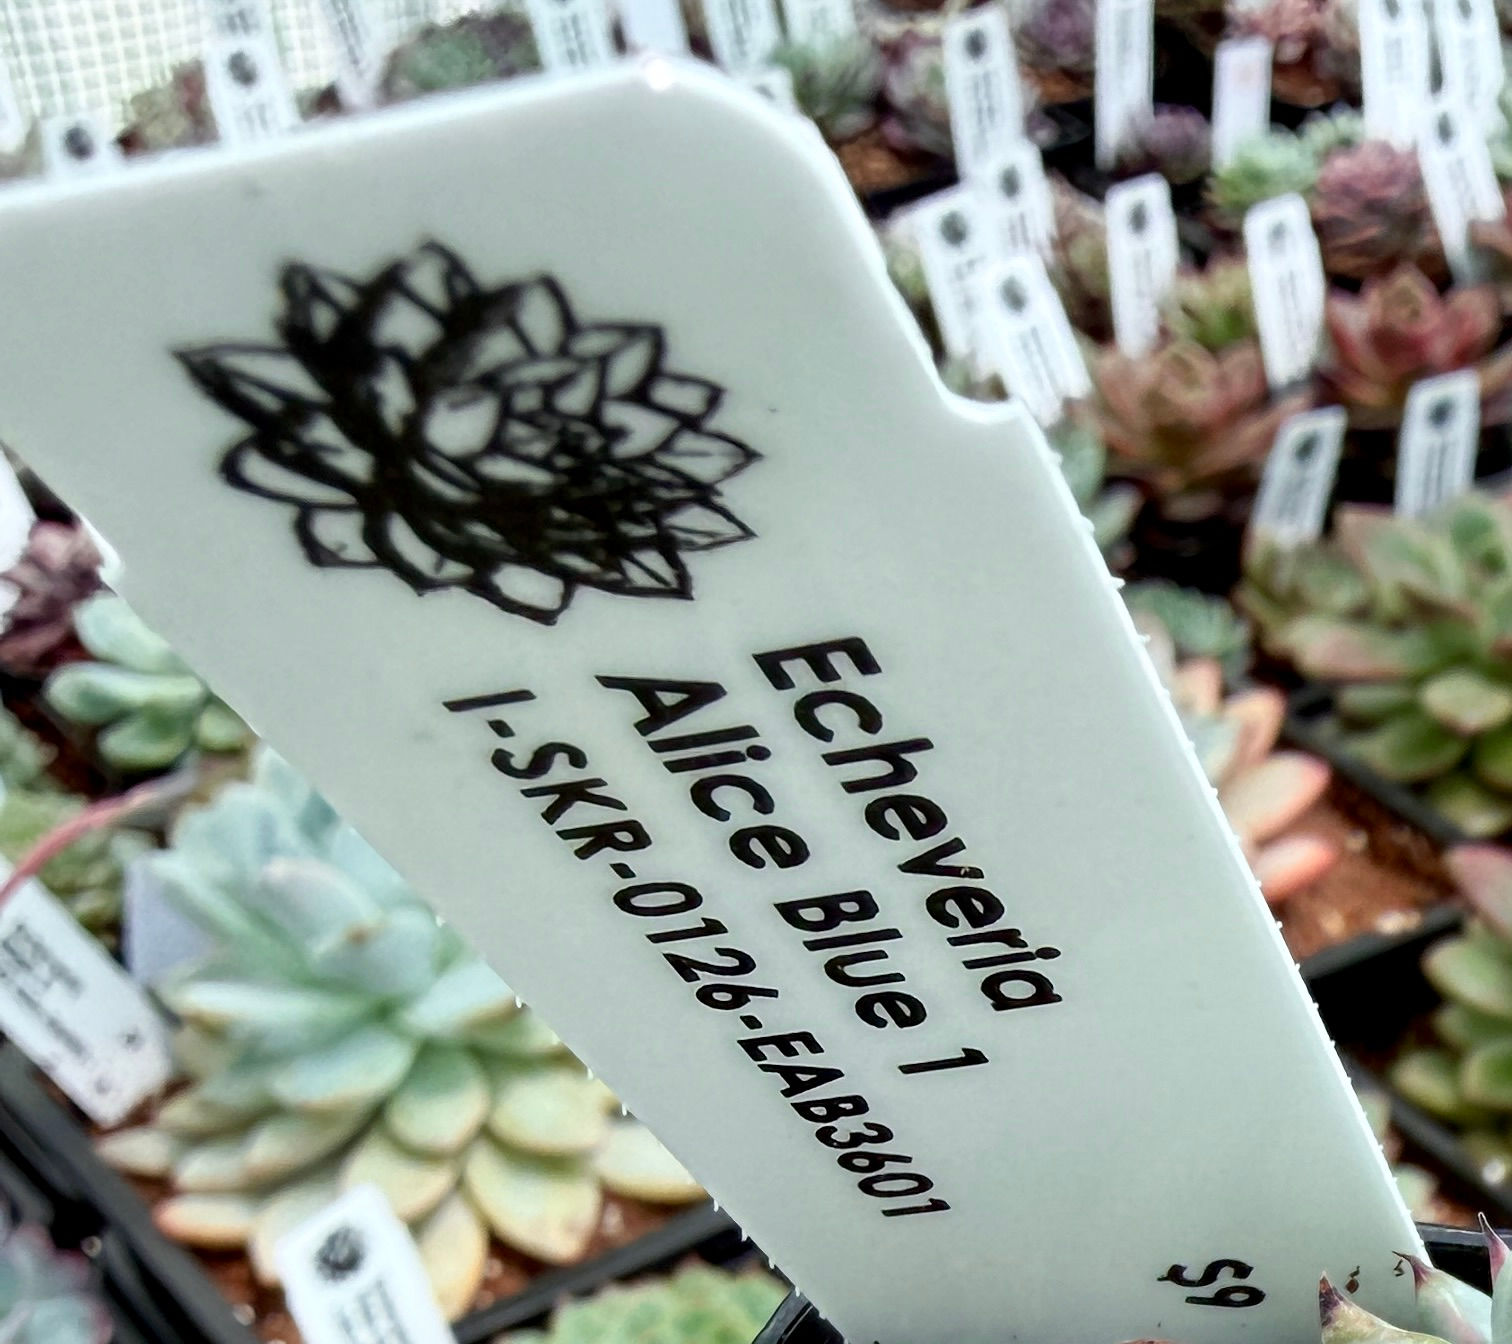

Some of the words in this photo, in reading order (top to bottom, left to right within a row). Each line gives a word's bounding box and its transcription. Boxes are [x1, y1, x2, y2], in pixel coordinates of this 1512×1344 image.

[444, 690, 951, 1217] I-SKR-0126-EAB3601
[595, 676, 810, 870] Alice
[777, 890, 927, 1028] Blue
[898, 1048, 989, 1074] 1
[752, 637, 1062, 1011] Echeveria
